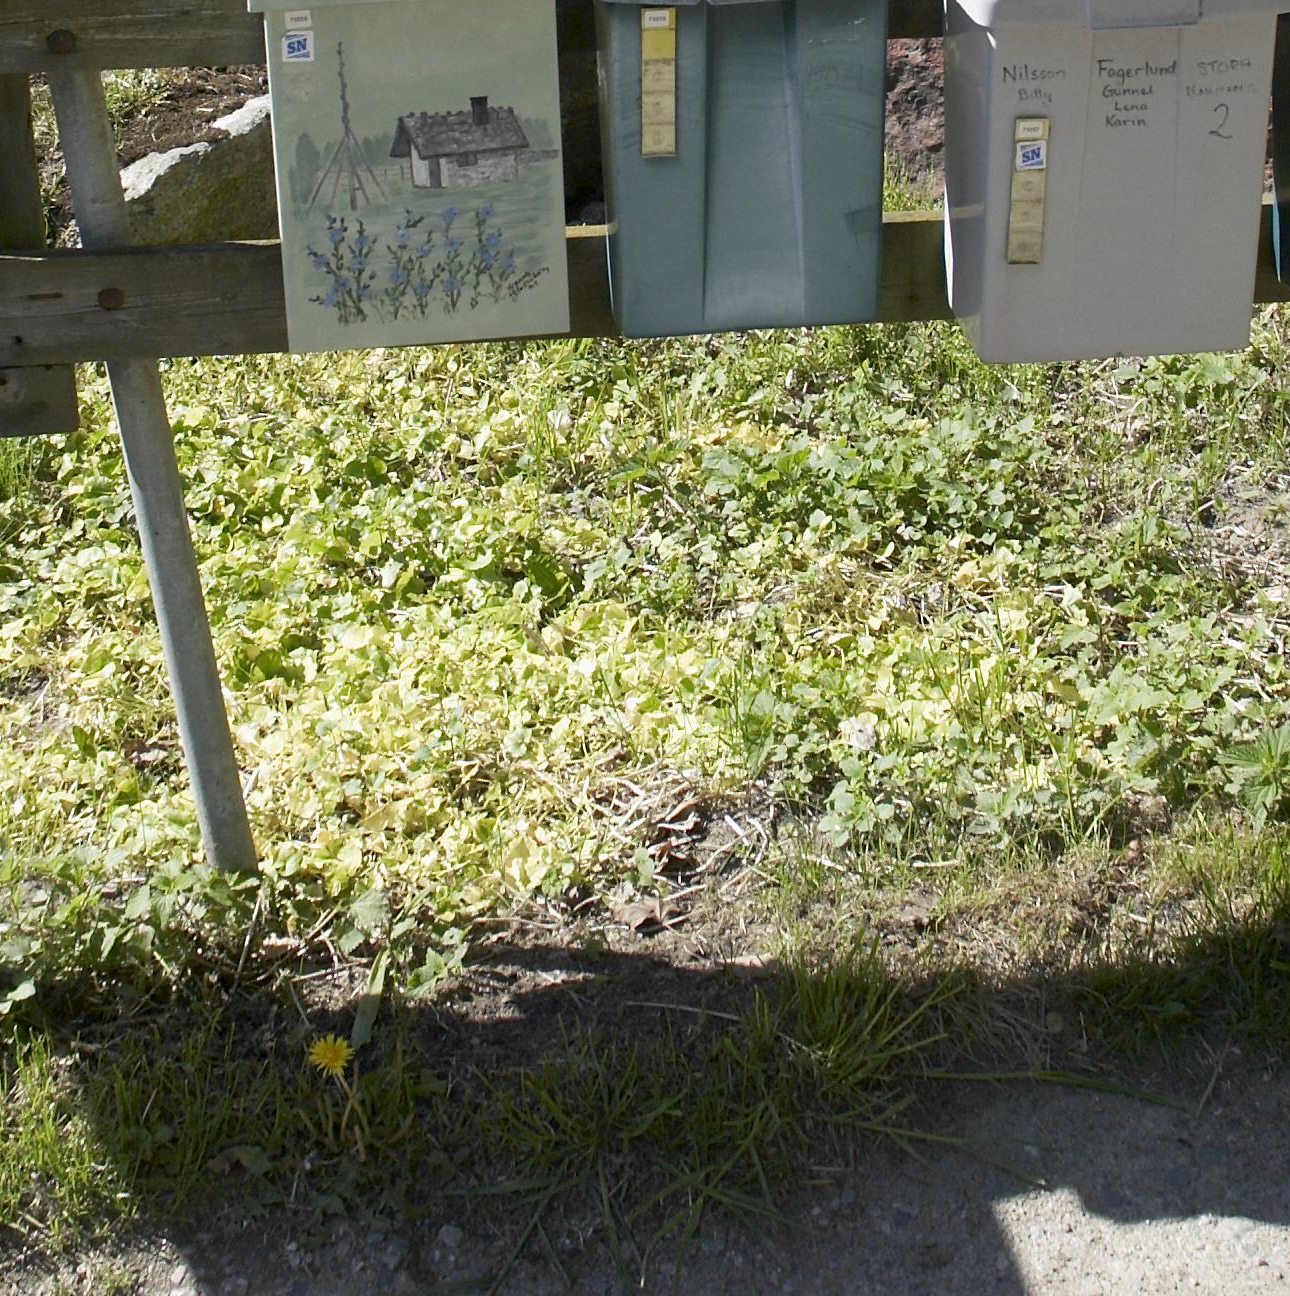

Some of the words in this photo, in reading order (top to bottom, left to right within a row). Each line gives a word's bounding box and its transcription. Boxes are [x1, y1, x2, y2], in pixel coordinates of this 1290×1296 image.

[286, 38, 308, 55] SN
[1002, 63, 1067, 83] Nilsson
[1096, 58, 1177, 85] Fagerlund
[1017, 87, 1052, 108] Billy
[1114, 101, 1149, 112] Lena
[1105, 114, 1147, 128] Karin
[1208, 103, 1233, 140] 2
[1021, 146, 1042, 164] SN
